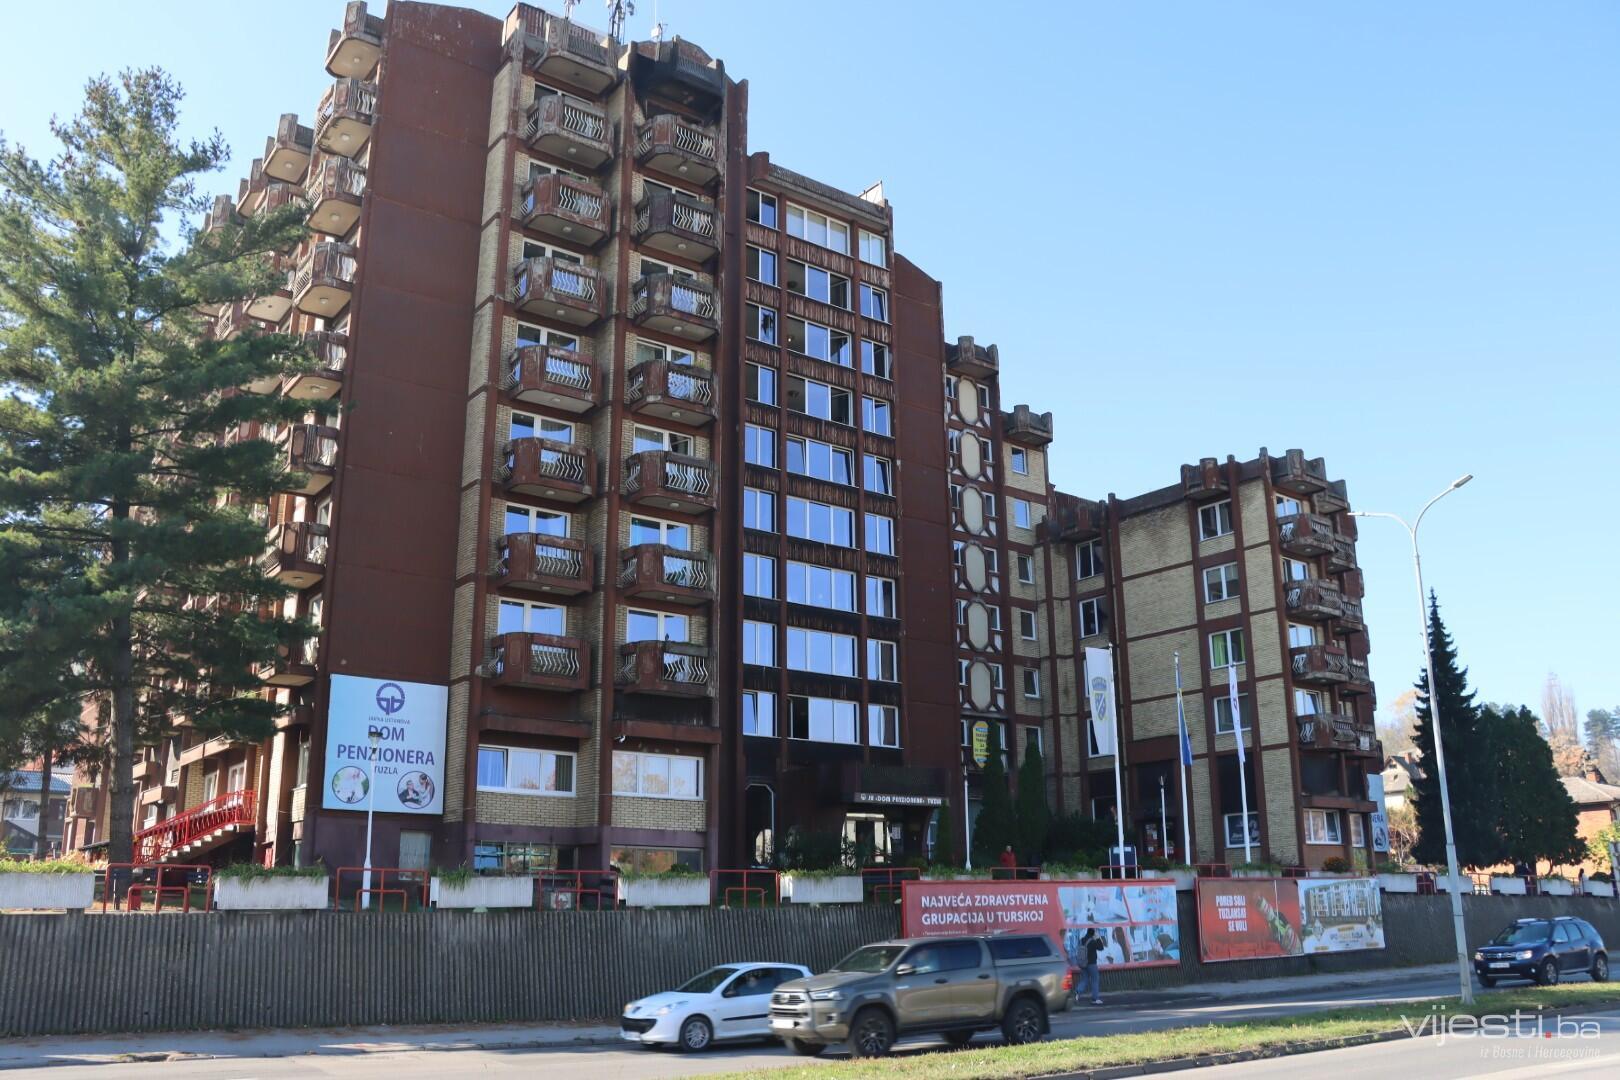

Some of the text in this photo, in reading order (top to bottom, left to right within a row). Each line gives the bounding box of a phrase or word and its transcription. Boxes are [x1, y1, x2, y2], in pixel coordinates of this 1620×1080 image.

[368, 724, 405, 741] DOM
[337, 744, 435, 765] PENZIONERA
[373, 765, 398, 775] TUZLA
[921, 892, 1049, 908] NAJVEĆA ZDRAVSTVENA
[921, 910, 1044, 925] GRUPACIJA U TURSKOJ
